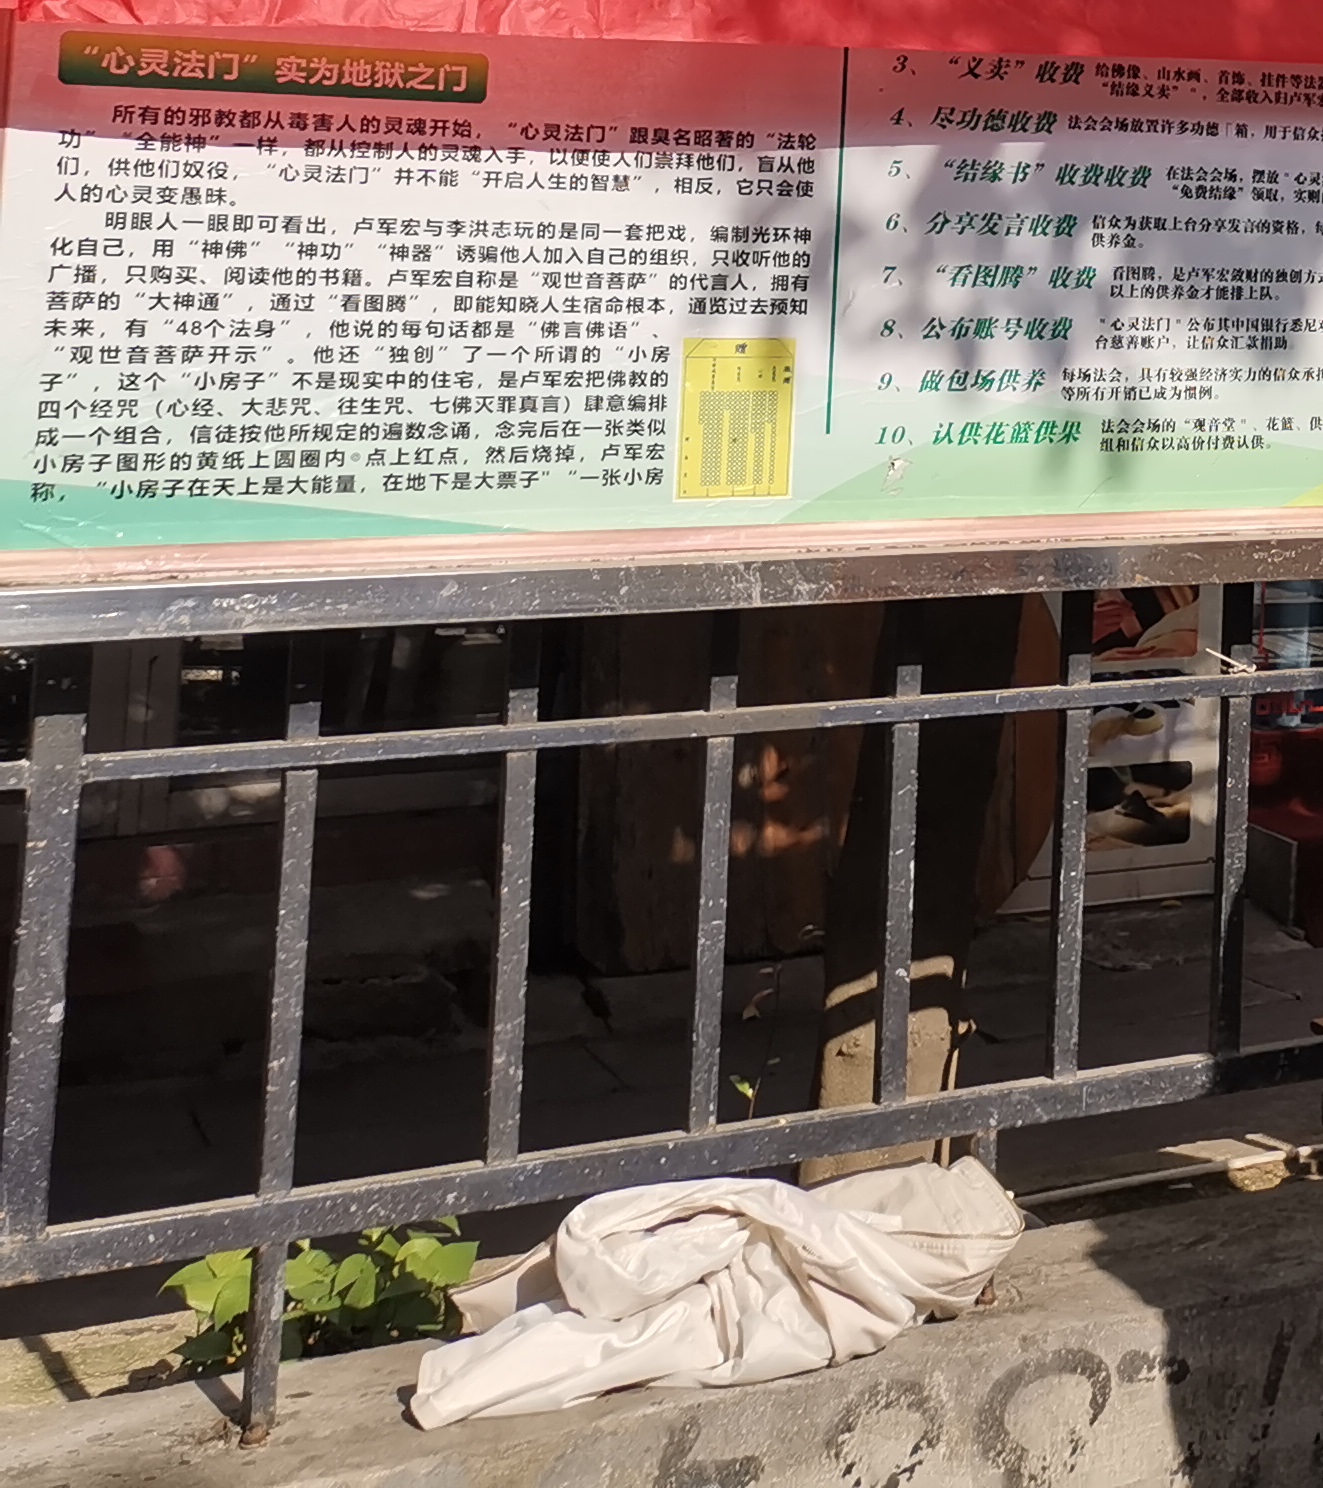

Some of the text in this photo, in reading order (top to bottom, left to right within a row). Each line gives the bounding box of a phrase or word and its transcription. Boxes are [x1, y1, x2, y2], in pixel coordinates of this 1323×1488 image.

[83, 45, 467, 92] “心灵法门”实为地狱之门
[890, 106, 1058, 135] 4、尽功德收费
[888, 159, 1152, 188] 5、“结缘书”收费收费
[55, 185, 238, 207] 人的心灵变愚昧。
[885, 211, 1078, 237] 6、分享发言收费
[1091, 233, 1144, 249] 供养金。
[882, 264, 1097, 290] 7、“看图腾”收费
[1110, 284, 1281, 301] 以上的供养金才能排上队。
[880, 316, 1073, 341] 8、公布账号收费
[877, 368, 1046, 393] 9、做包场供养
[1061, 385, 1222, 402] 等所有开销已成为惯例。
[874, 420, 1082, 446] 10、认供花篮供果
[1099, 436, 1272, 453] 组和信众以高价付费认供。
